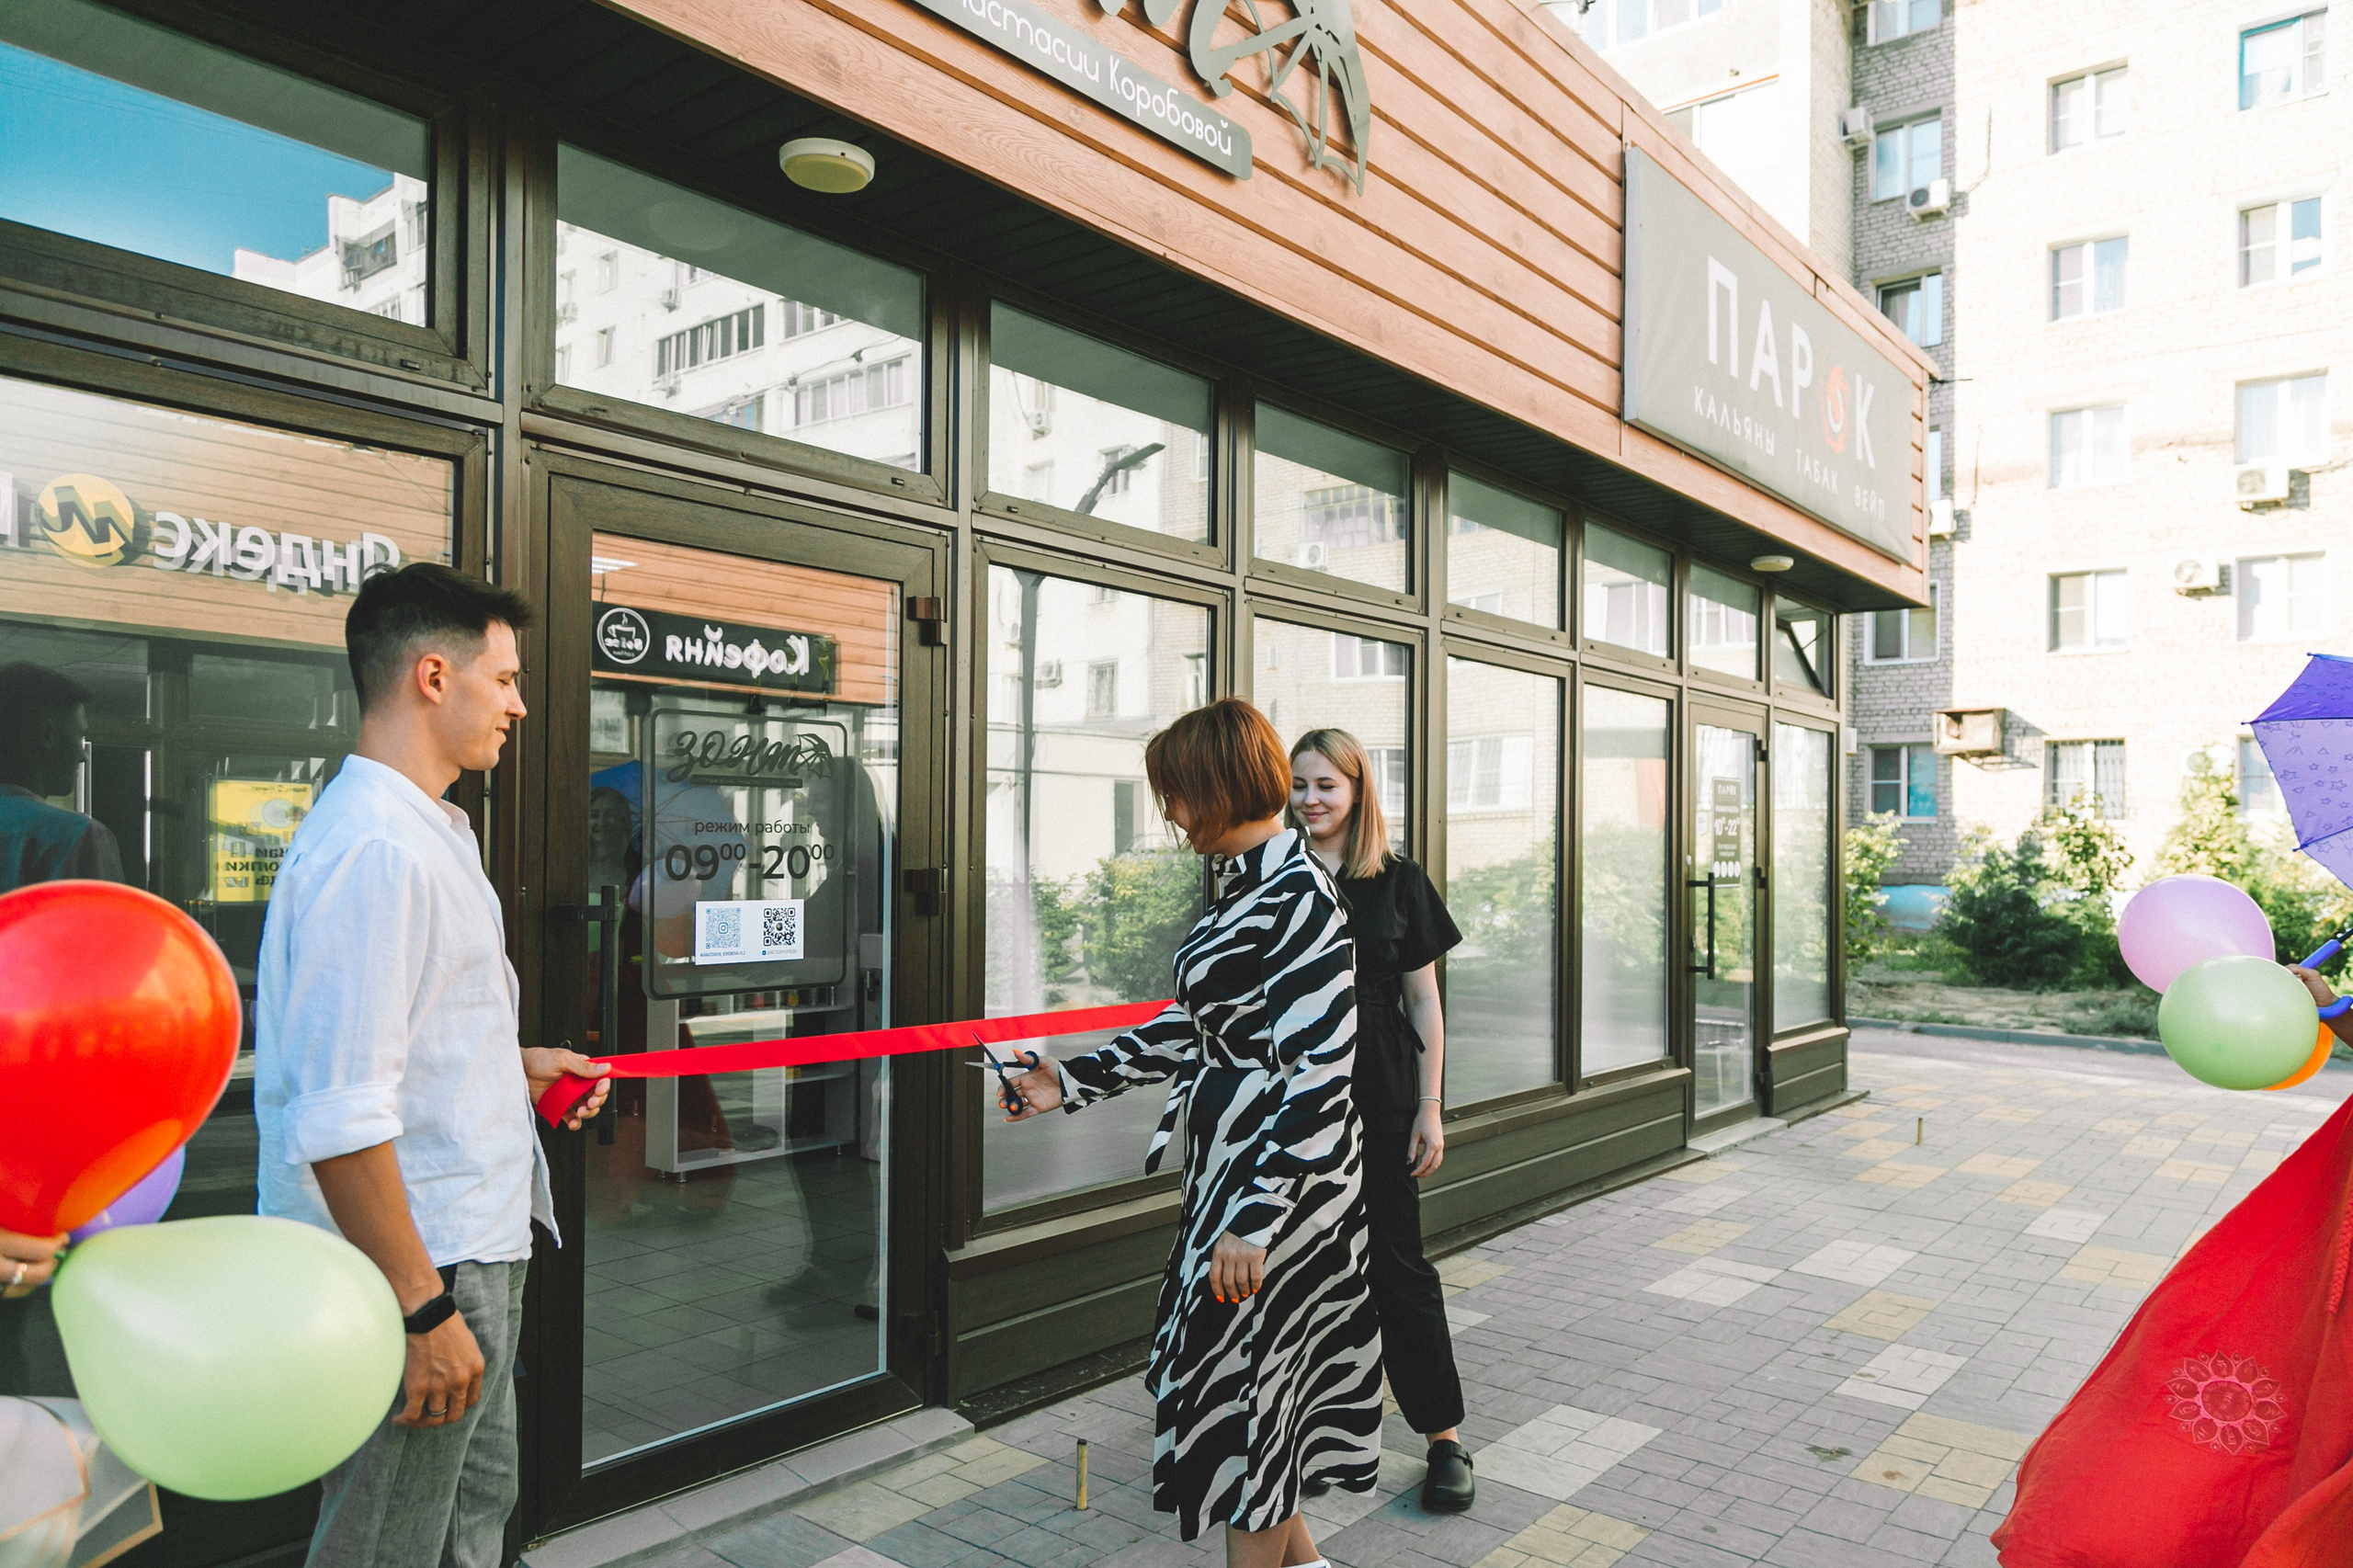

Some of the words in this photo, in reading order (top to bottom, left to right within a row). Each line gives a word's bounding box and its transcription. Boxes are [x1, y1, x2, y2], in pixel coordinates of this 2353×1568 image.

[961, 0, 1099, 84] астасии
[1108, 54, 1232, 157] Коробовой
[1693, 385, 1776, 458] КАЛЬЯНЫ
[1795, 447, 1839, 496] ТАБАК
[1854, 487, 1886, 521] ВЕЙП
[695, 822, 750, 835] режим
[755, 819, 810, 835] работы
